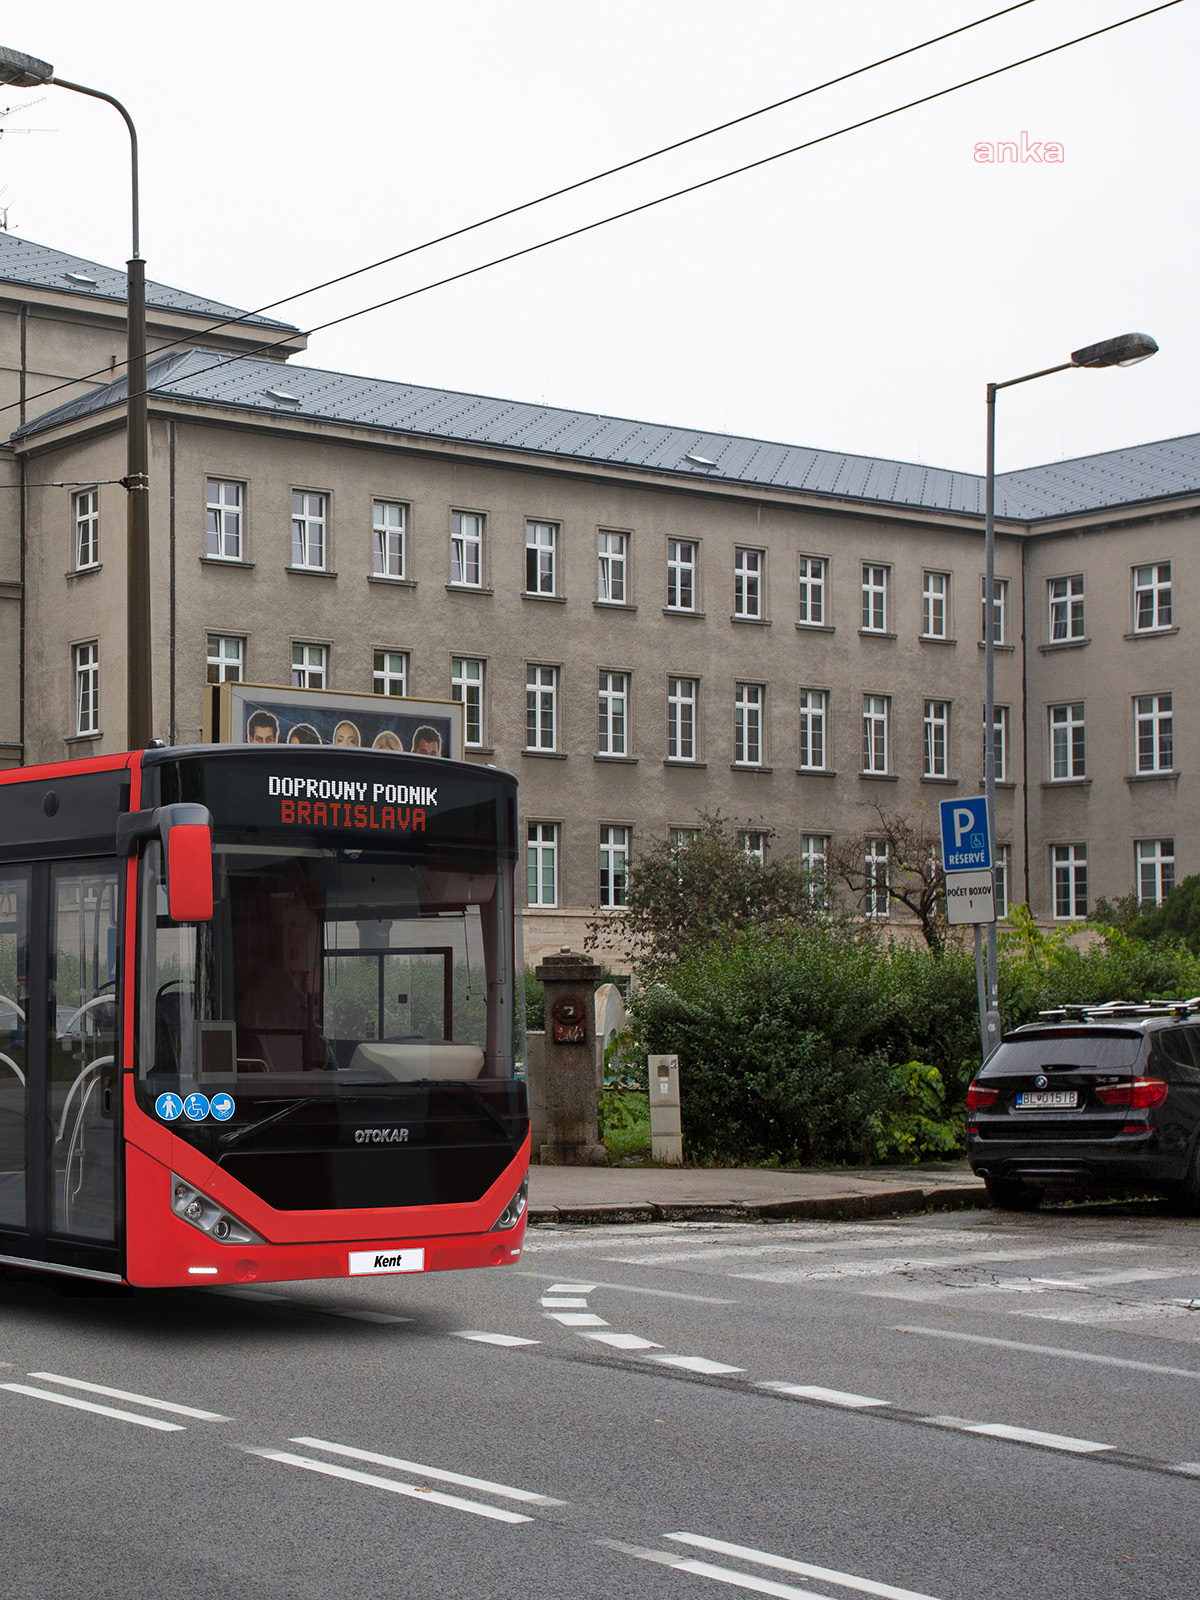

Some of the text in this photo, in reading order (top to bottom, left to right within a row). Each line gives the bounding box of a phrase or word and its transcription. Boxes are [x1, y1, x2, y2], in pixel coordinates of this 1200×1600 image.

[373, 783, 438, 806] PODNIK
[281, 800, 426, 832] BRATISLAVA
[953, 808, 975, 848] P
[949, 851, 985, 865] RÉSERVÉ
[947, 886, 991, 897] POČET BOXOV
[968, 900, 973, 909] 1
[354, 1128, 409, 1143] OTOKAR
[374, 1255, 402, 1268] Kent
